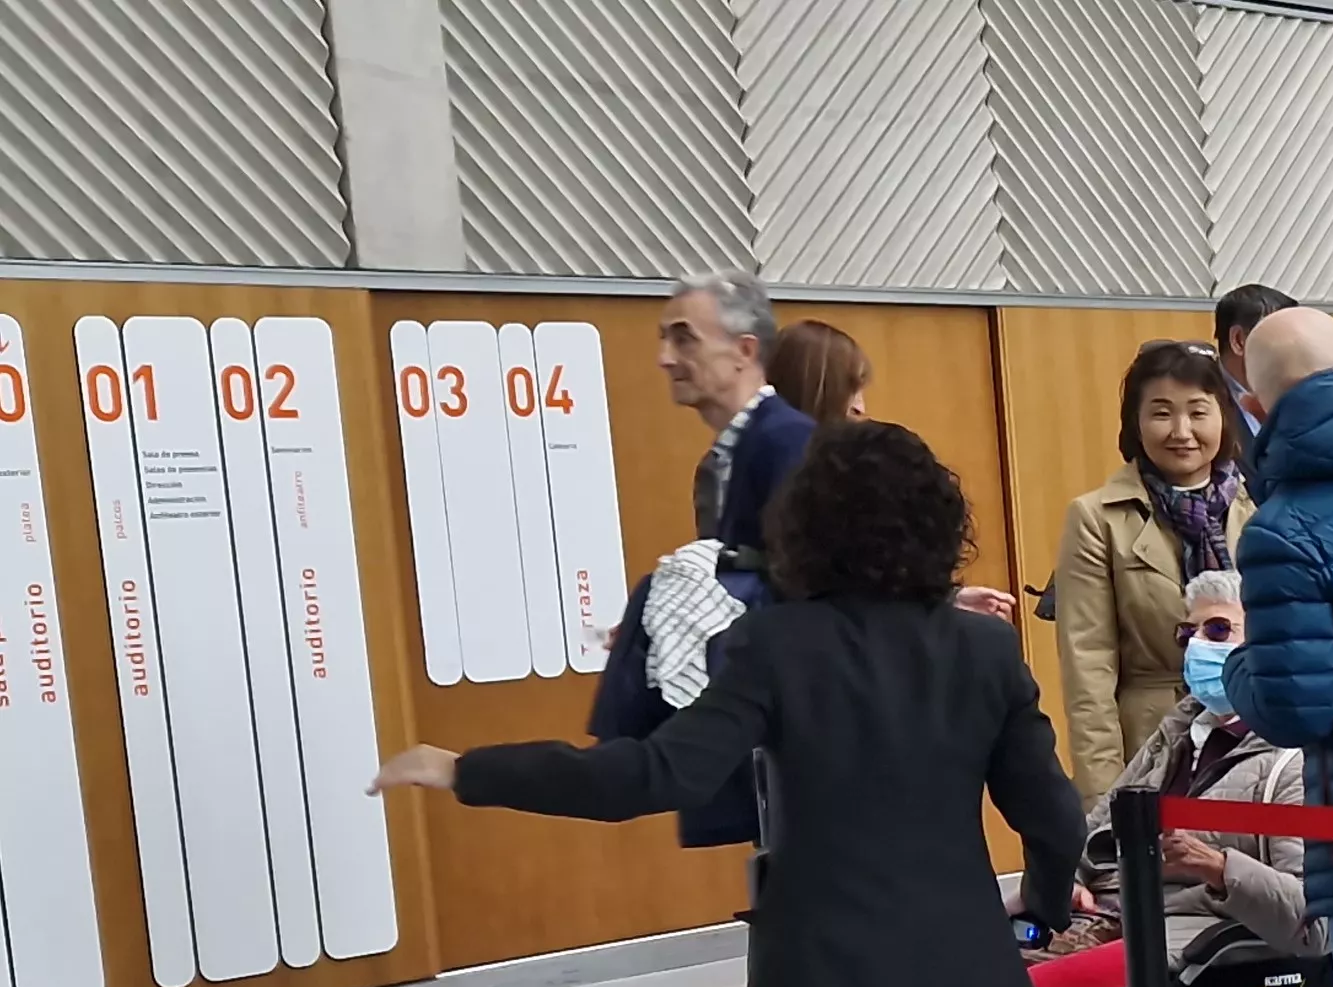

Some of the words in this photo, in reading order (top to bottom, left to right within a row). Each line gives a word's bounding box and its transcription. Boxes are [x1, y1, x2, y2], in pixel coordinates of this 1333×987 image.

[86, 364, 158, 423] 01
[221, 364, 299, 421] 02
[400, 365, 468, 418] 03
[507, 365, 574, 417] 04
[20, 502, 36, 543] platea
[113, 499, 128, 540] palcos
[118, 579, 149, 697] auditorio
[299, 567, 327, 679] auditorio
[576, 569, 595, 657] Trraza
[24, 583, 57, 703] auditorio
